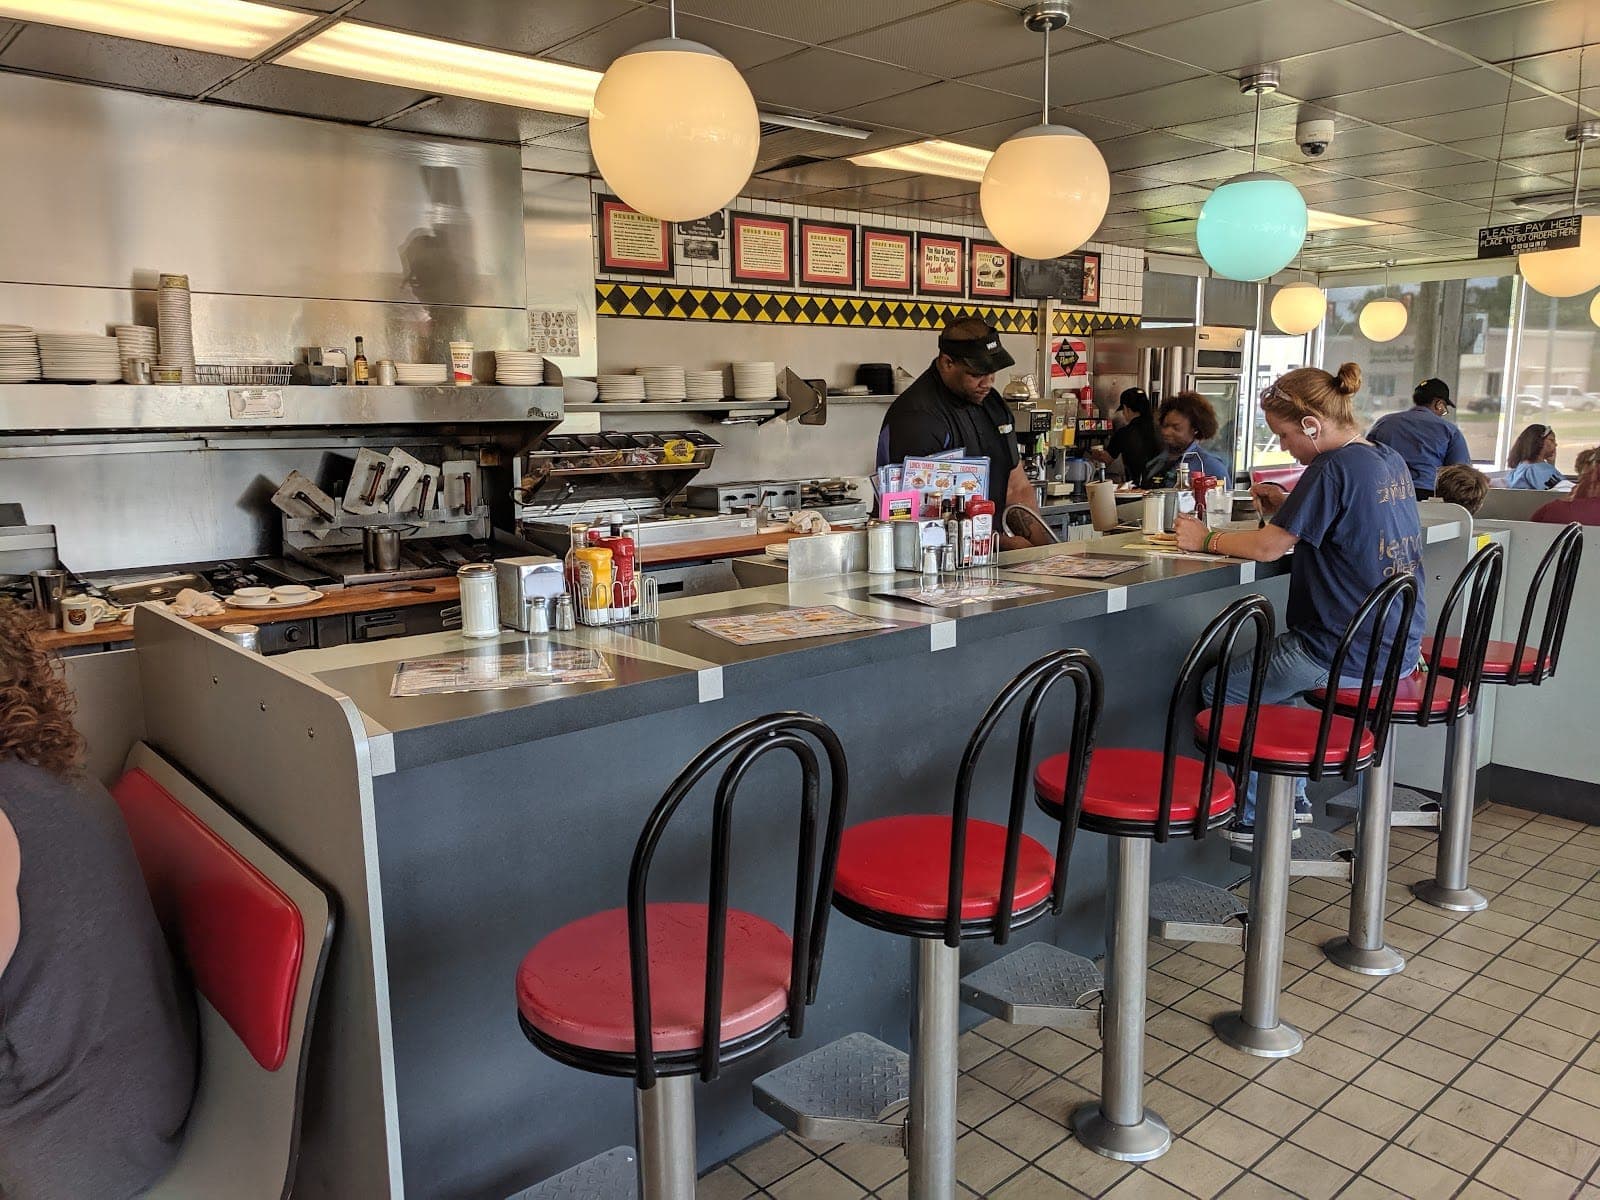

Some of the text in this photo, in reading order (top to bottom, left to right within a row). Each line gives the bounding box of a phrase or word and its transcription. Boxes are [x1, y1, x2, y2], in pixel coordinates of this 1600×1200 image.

[1481, 218, 1579, 239] PLEASE PAY HERE
[1481, 238, 1503, 247] PLACE
[1505, 236, 1515, 244] TO
[1516, 234, 1526, 242] GO
[1528, 231, 1557, 241] ORDERS
[1560, 228, 1578, 237] HERE
